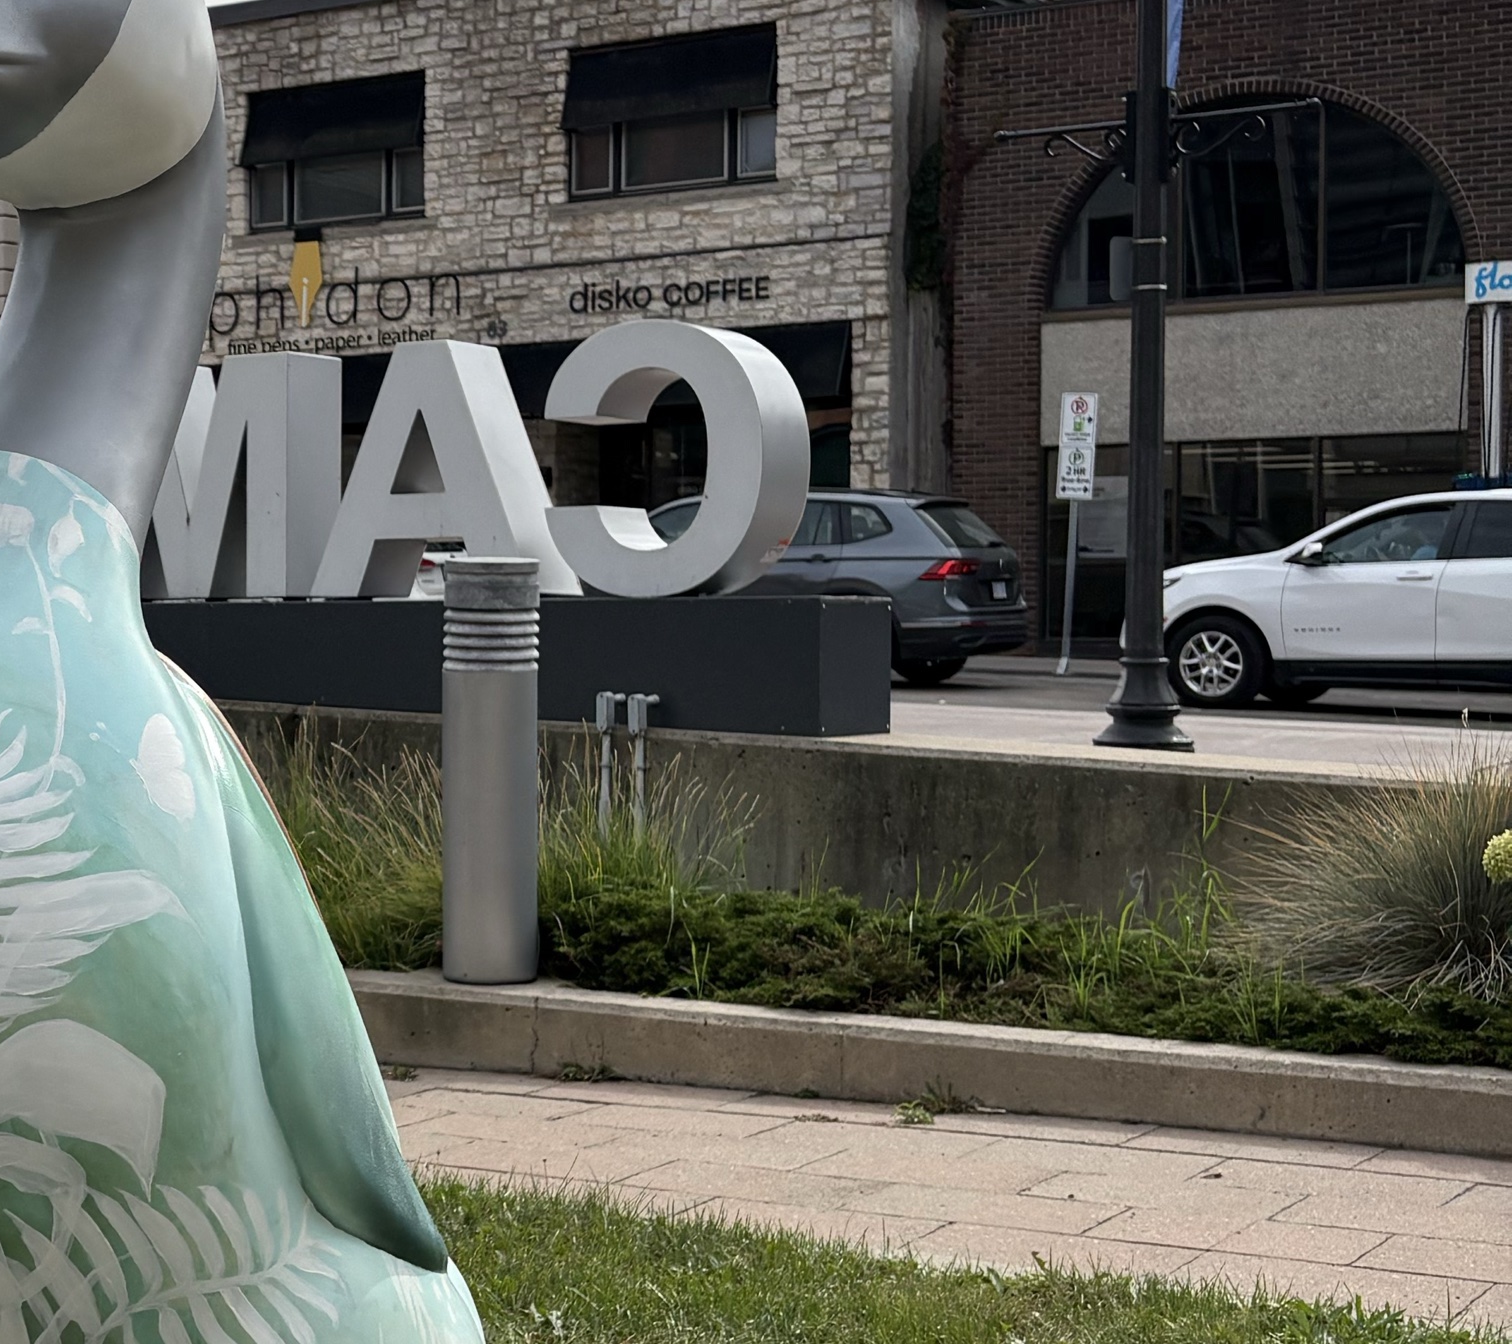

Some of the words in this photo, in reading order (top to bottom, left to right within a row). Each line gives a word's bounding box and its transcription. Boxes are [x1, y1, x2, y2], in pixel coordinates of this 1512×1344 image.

[208, 266, 462, 349] phidon
[569, 279, 652, 315] disko
[662, 275, 771, 307] COFFEE
[227, 338, 257, 356] fine
[314, 334, 364, 354] paper
[377, 325, 437, 346] leather
